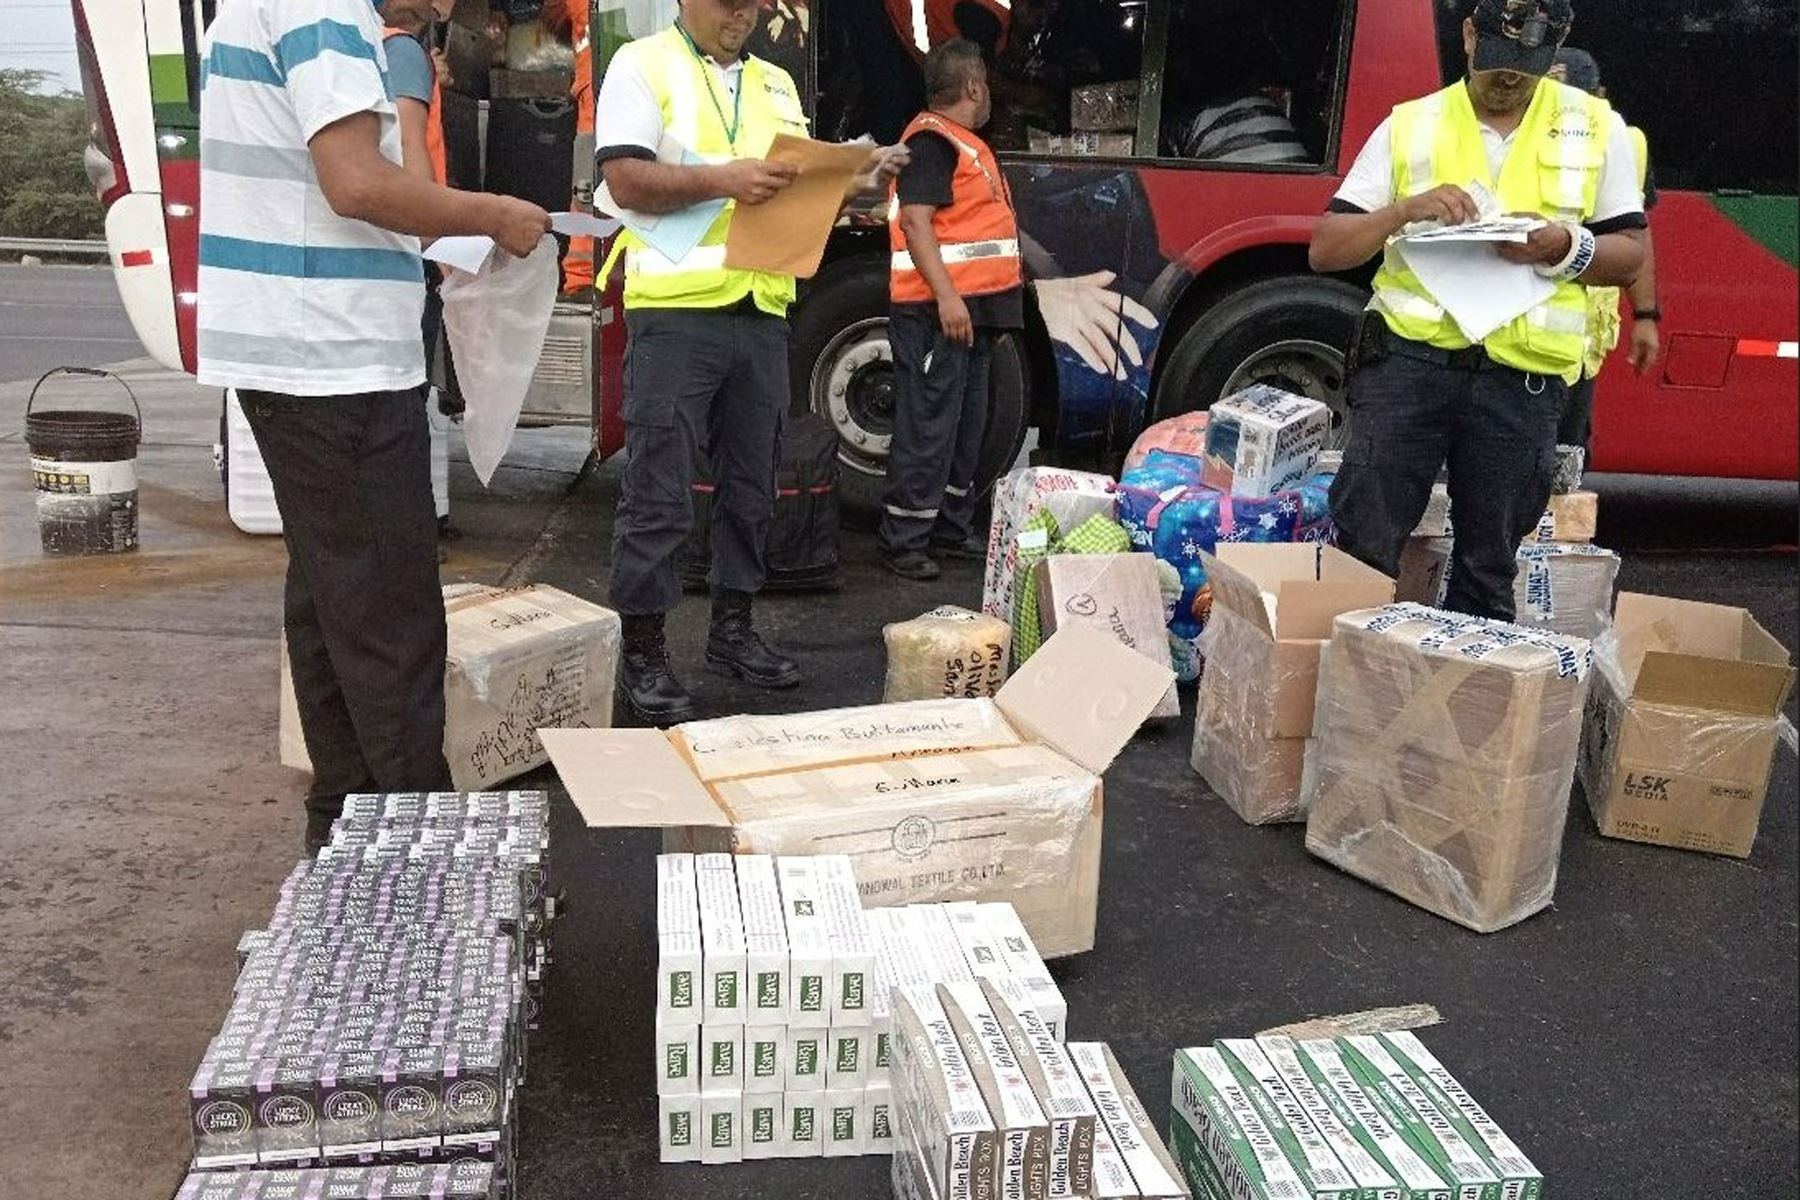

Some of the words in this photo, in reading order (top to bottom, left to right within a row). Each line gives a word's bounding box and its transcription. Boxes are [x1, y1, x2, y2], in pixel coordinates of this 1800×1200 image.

[1527, 572, 1543, 605] SUNAT
[1624, 773, 1672, 793] LSK
[673, 972, 691, 1008] Rave
[717, 972, 735, 1008] Rave
[760, 973, 778, 1008] Rave
[803, 977, 821, 1011] Rave
[844, 973, 862, 1009] Rave
[669, 1043, 687, 1077] Rave
[714, 1042, 732, 1076] Rave
[757, 1042, 775, 1076] Rave
[797, 1040, 815, 1074] Rave
[839, 1039, 857, 1072] Rave
[671, 1112, 689, 1146] Rave
[713, 1114, 731, 1147] Rave
[755, 1108, 773, 1142] Rave
[795, 1108, 813, 1141] Rave
[835, 1108, 852, 1139] Rave
[1052, 1155, 1068, 1195] Golden
[1077, 1153, 1090, 1190] LIGHTS
